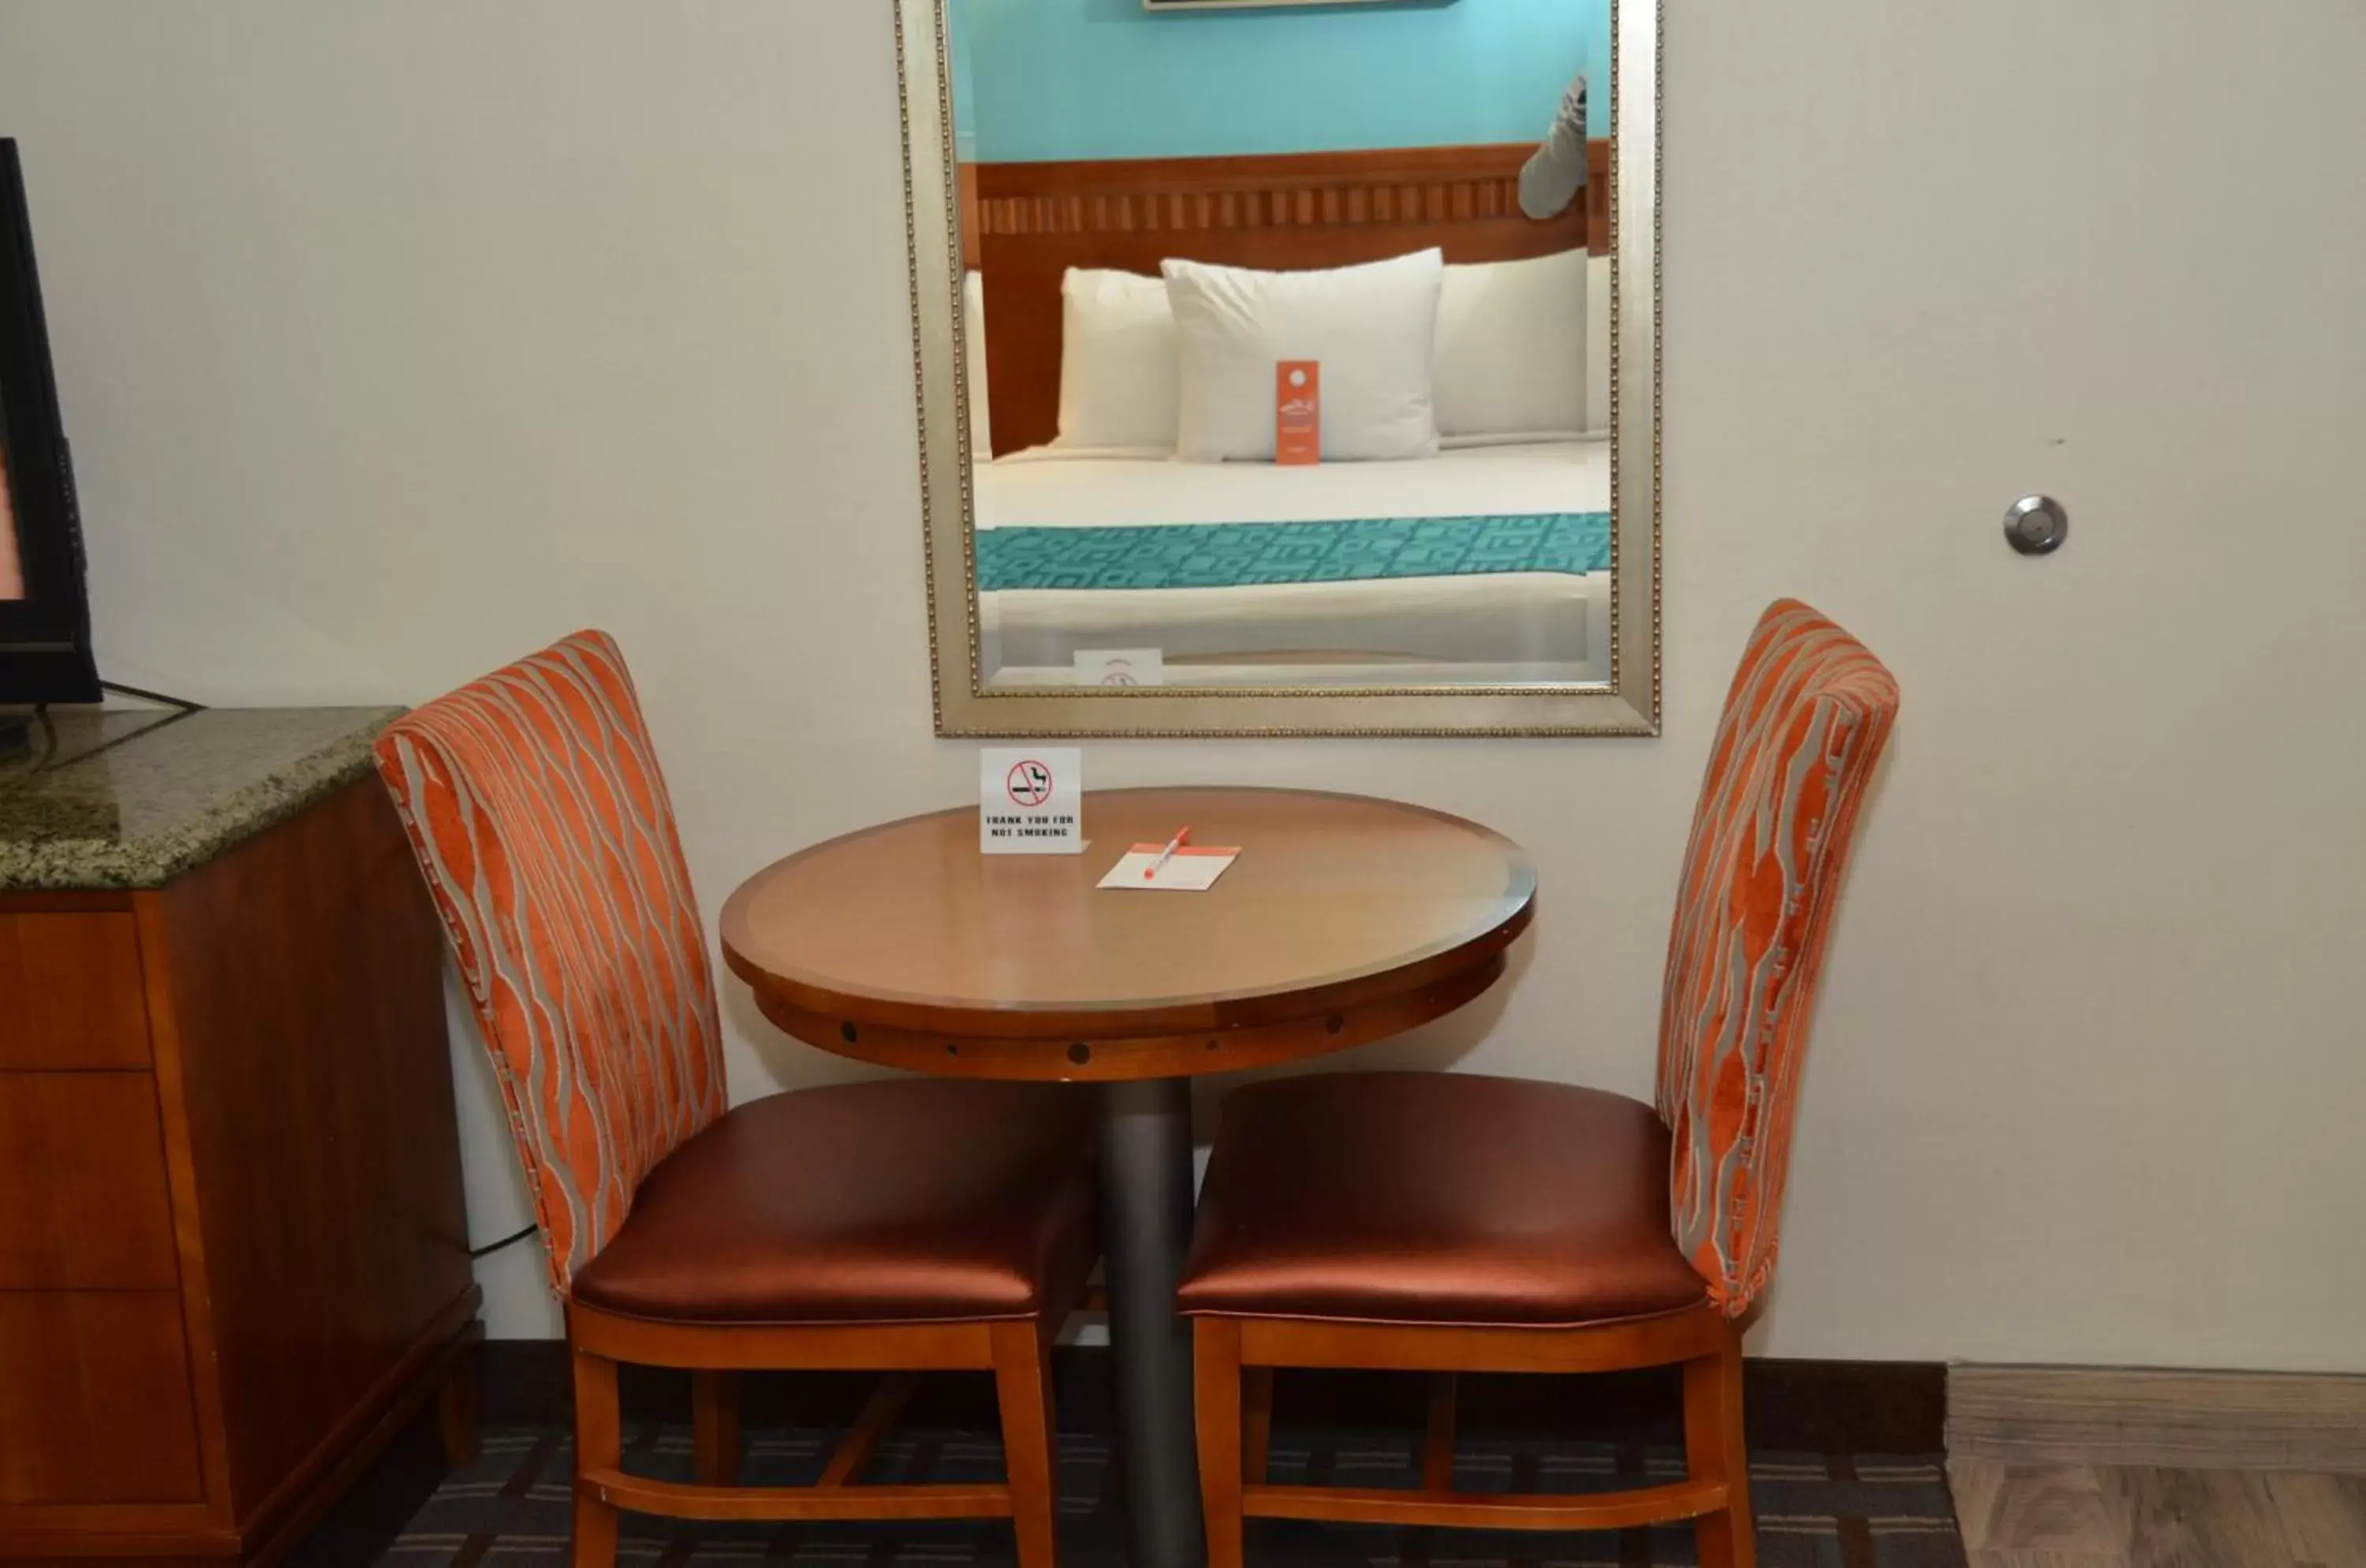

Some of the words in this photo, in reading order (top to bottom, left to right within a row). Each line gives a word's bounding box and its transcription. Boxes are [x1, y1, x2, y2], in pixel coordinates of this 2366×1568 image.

[1028, 816, 1049, 824] YOU
[1053, 816, 1074, 824] FOR
[991, 828, 1013, 837] NOT
[1017, 828, 1068, 837] SMOKING
